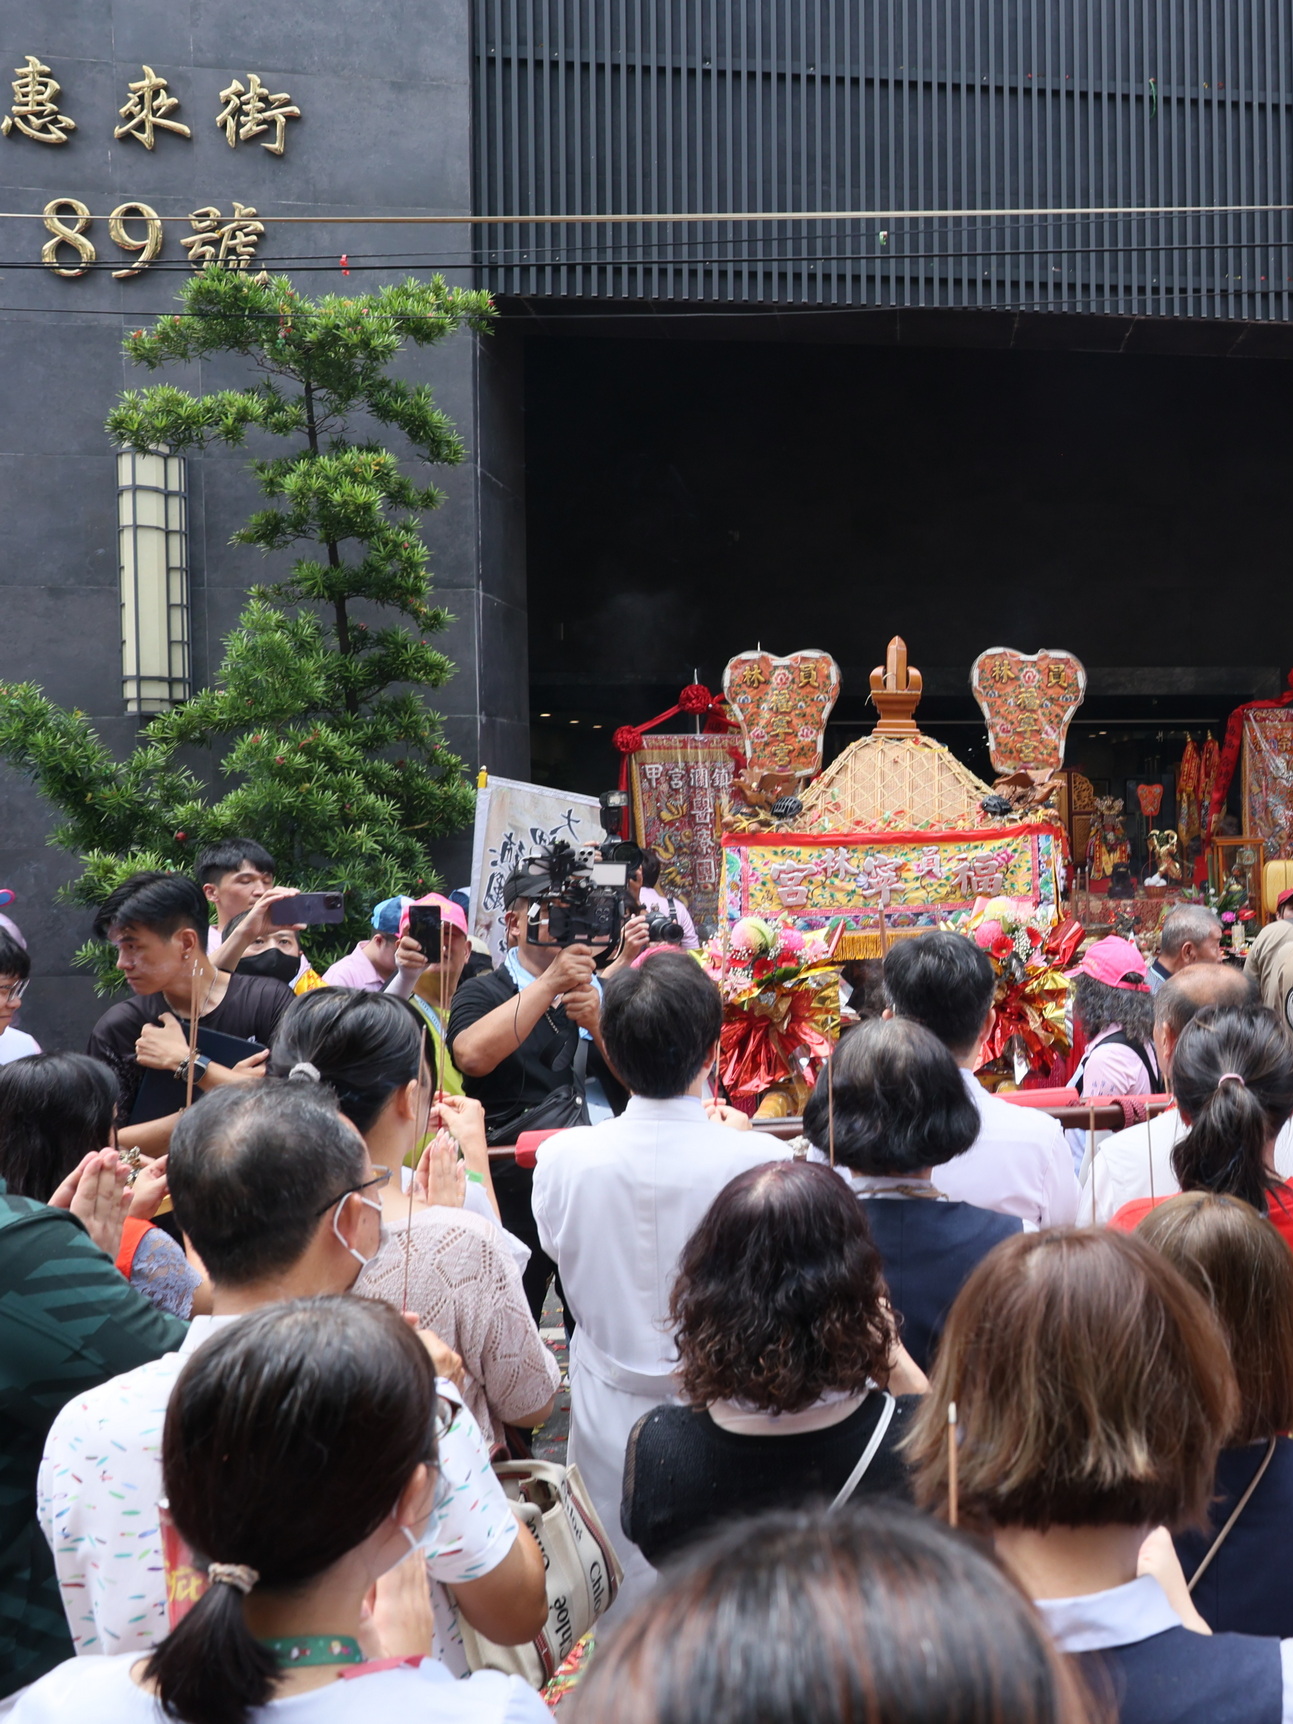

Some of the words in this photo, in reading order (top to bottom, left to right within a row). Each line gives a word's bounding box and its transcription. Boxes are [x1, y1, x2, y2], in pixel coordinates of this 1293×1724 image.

[1, 55, 301, 155] 惠來街
[41, 198, 271, 285] 89號
[589, 1560, 606, 1613] Chlo
